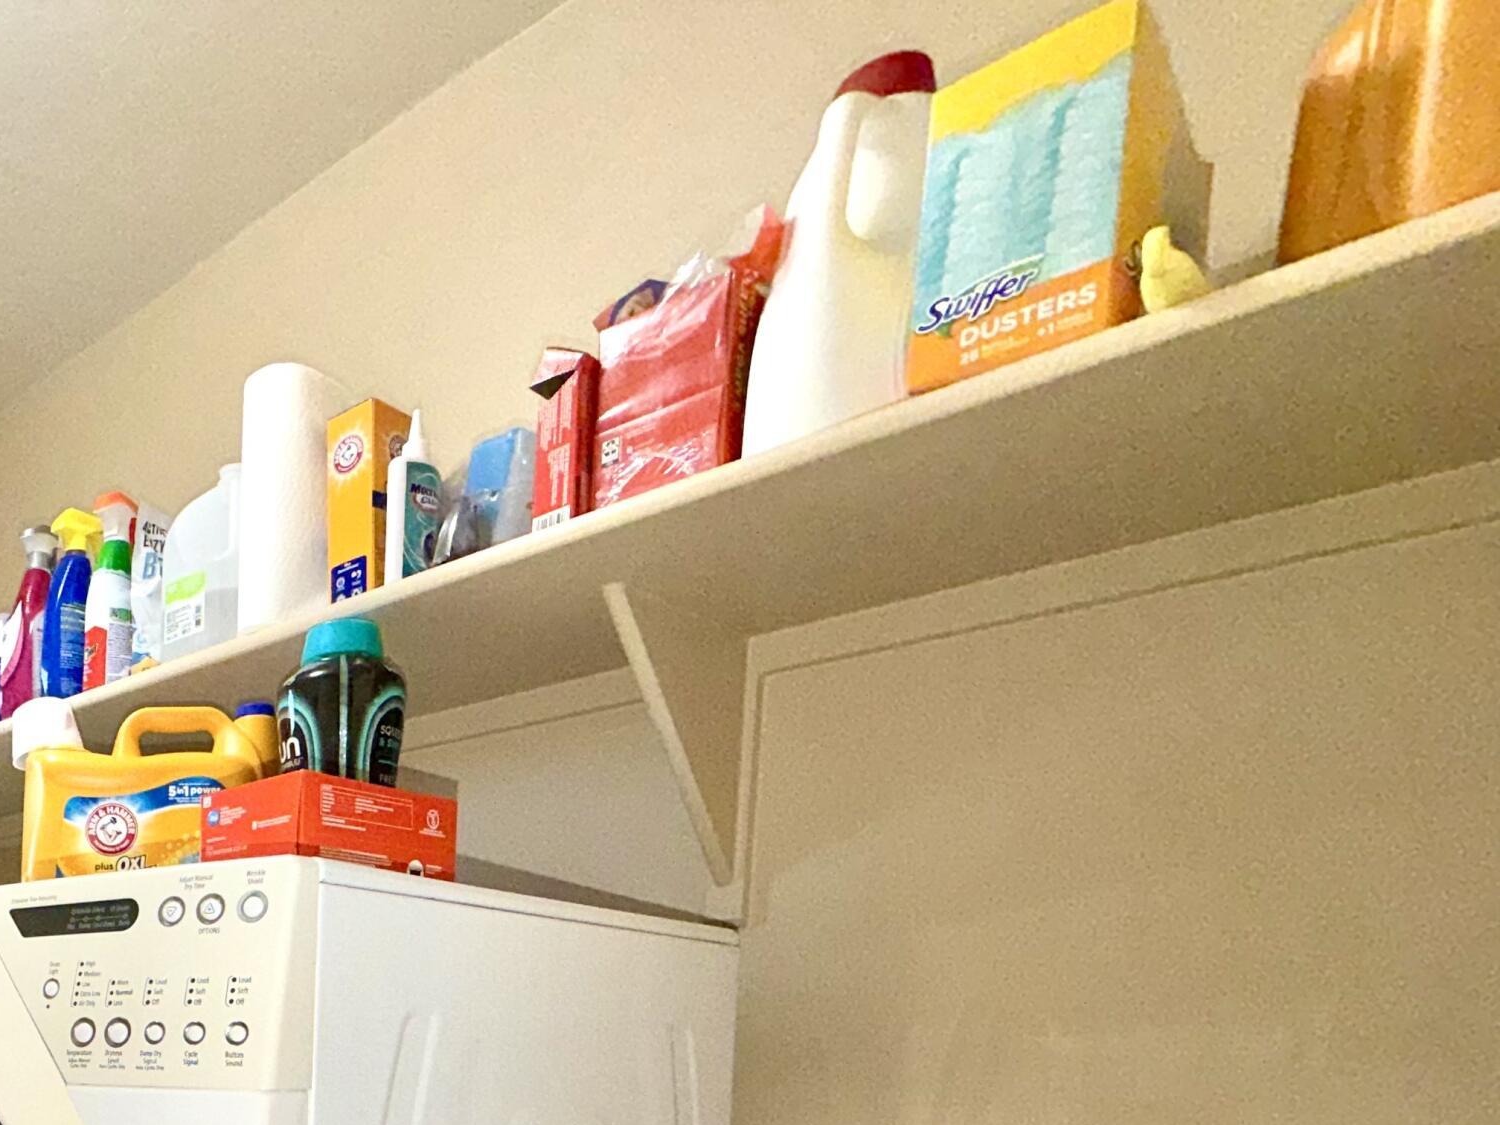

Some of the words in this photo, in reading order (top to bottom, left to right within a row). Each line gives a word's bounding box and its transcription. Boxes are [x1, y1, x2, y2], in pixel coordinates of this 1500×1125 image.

[917, 270, 1036, 333] Swiffer
[959, 282, 1098, 349] DUSTERS
[94, 862, 114, 873] plus
